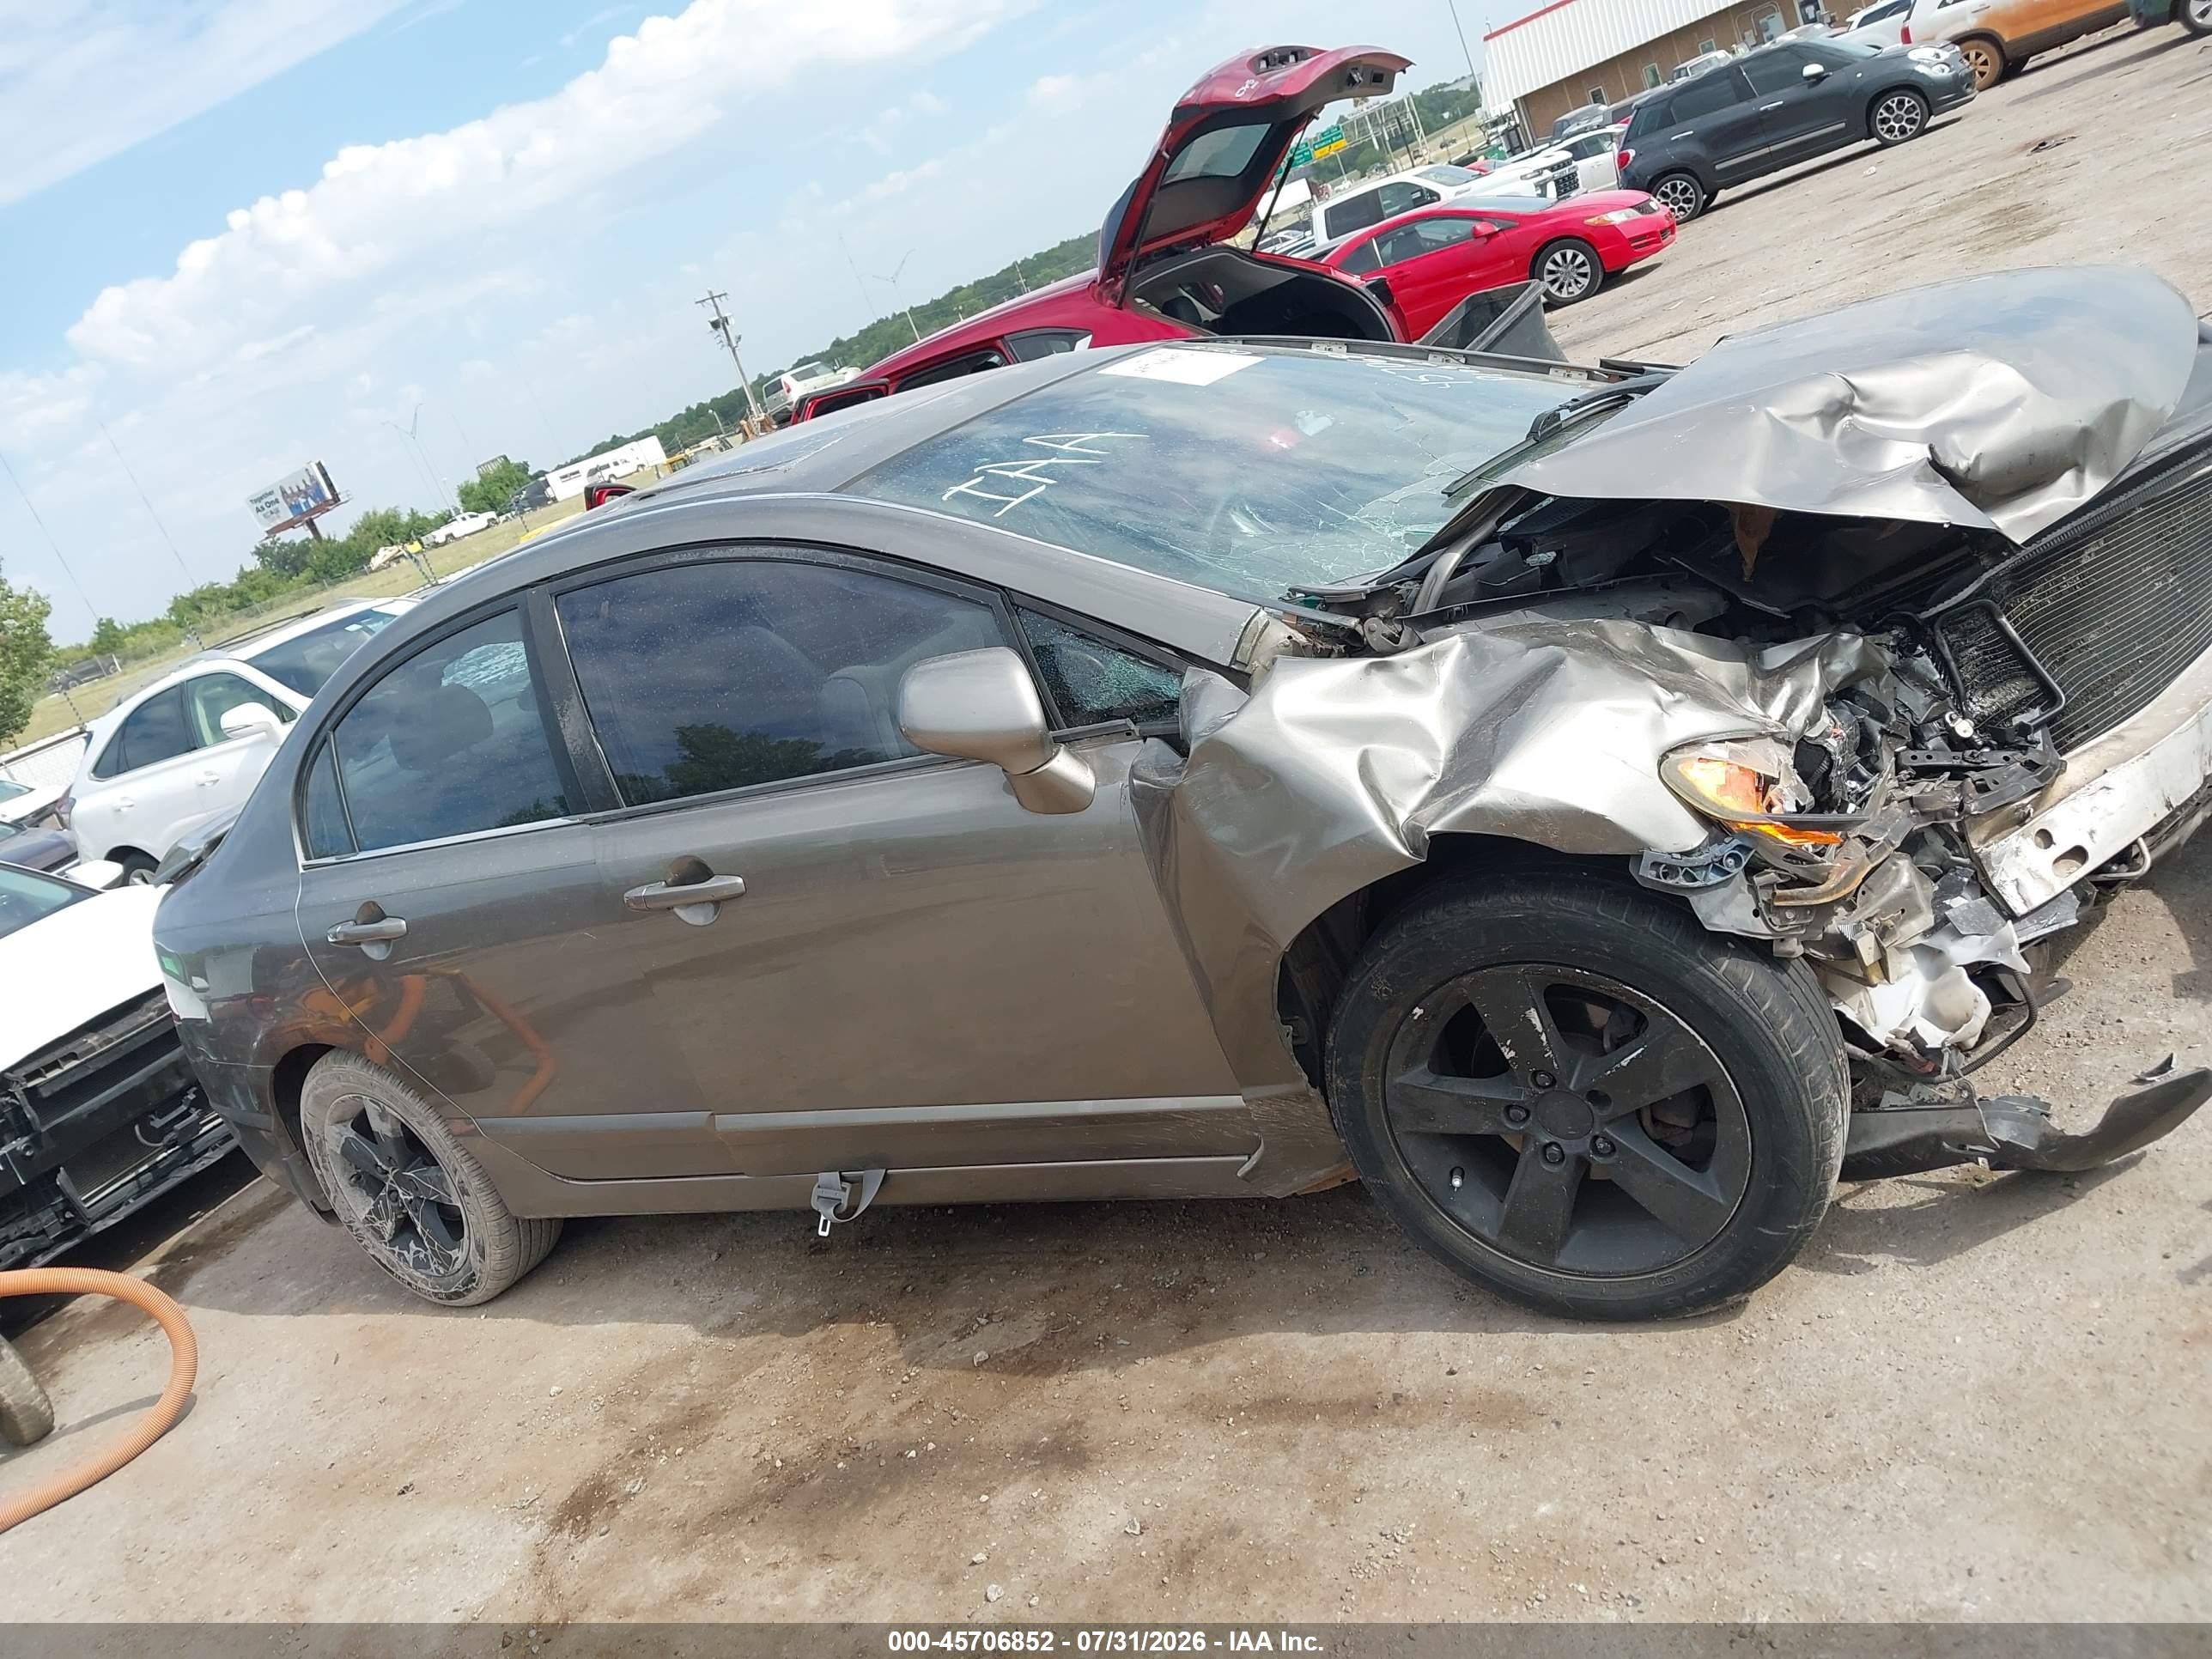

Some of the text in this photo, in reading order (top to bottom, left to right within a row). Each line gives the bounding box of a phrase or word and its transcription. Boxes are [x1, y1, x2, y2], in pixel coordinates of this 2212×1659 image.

[942, 431, 1150, 517] IAA
[249, 489, 275, 504] Together
[255, 505, 265, 514] As
[264, 497, 280, 508] One
